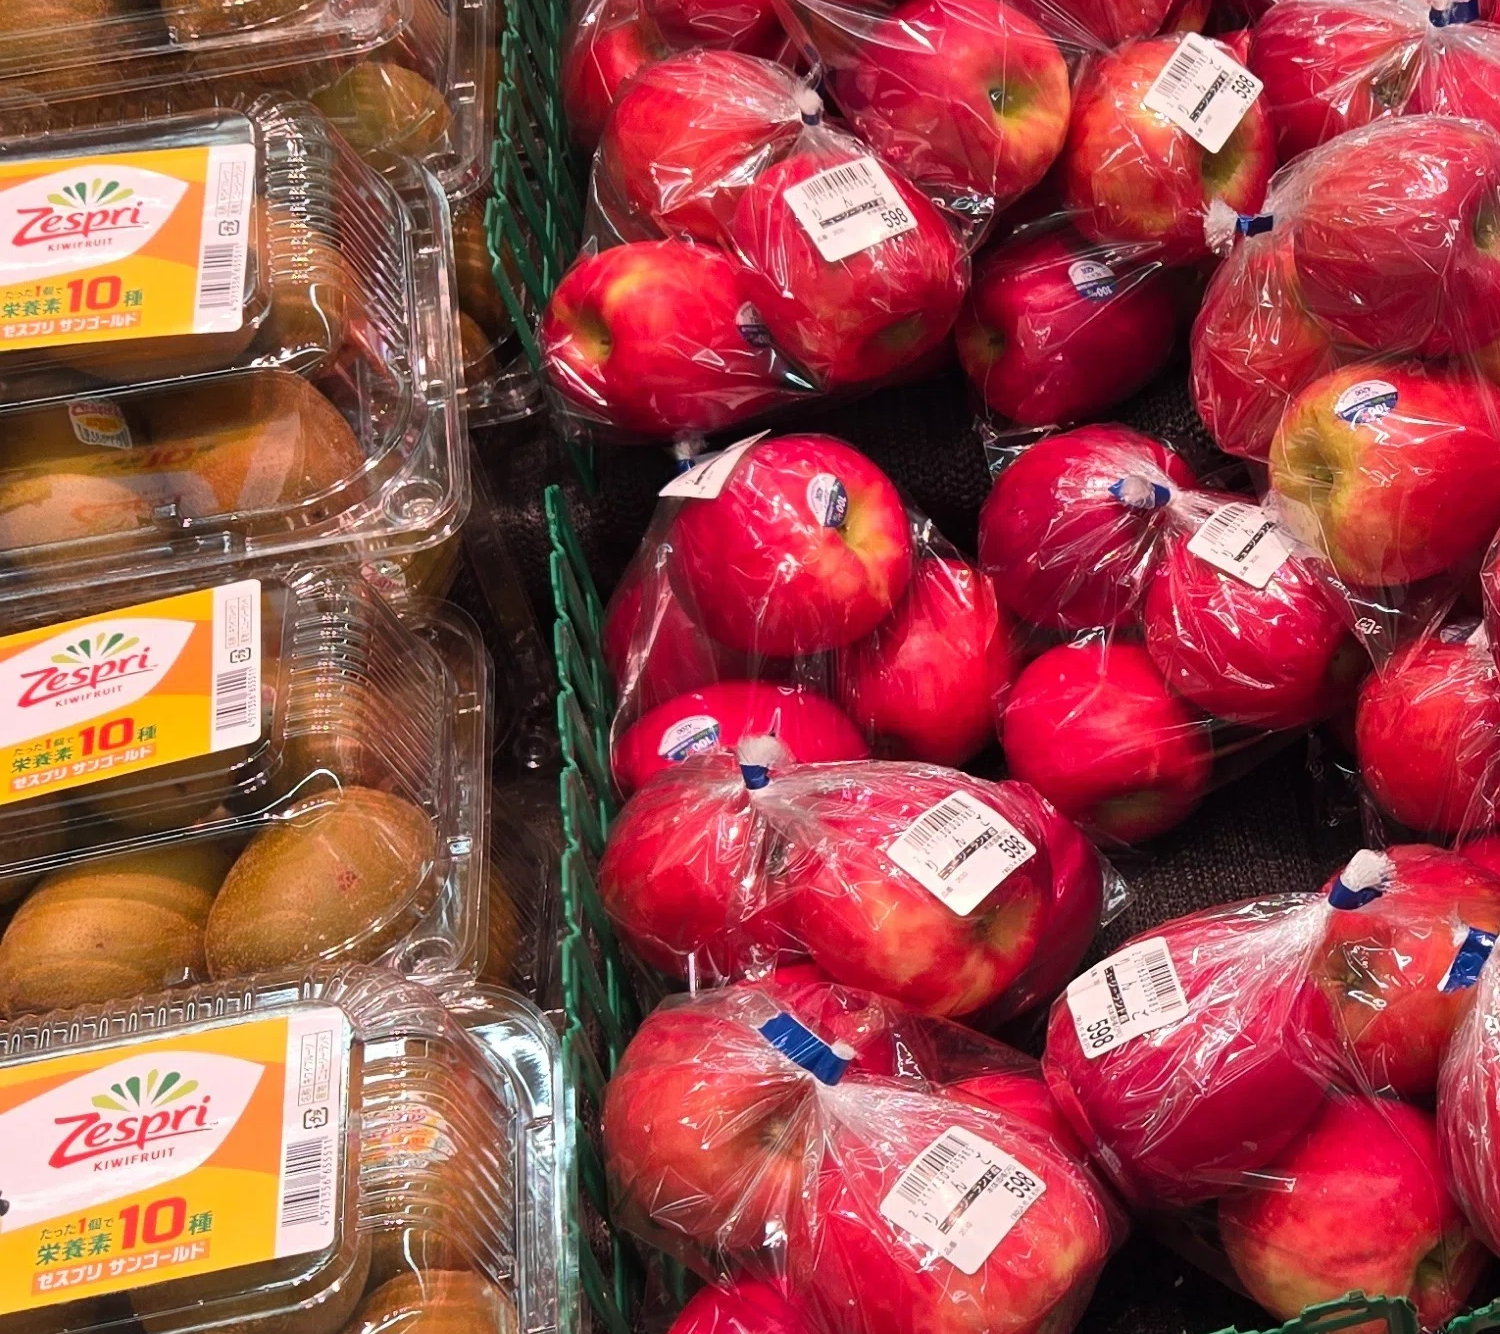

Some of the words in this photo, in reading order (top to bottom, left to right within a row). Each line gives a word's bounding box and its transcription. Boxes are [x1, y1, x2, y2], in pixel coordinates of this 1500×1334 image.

[1231, 73, 1256, 100] 598
[12, 202, 142, 248] Zespri
[881, 207, 908, 229] 598
[47, 237, 113, 252] KIWIFRUIT
[3, 319, 55, 338] ゼスプリ
[60, 312, 139, 333] サンゴールド
[18, 646, 151, 708] Zespri
[55, 684, 123, 708] KIWIFRUIT
[13, 768, 68, 788] ゼスプリ
[73, 746, 153, 775] サンゴールド
[998, 834, 1028, 860] 598
[1086, 1018, 1114, 1050] 598
[48, 1095, 211, 1169] Zespri
[93, 1146, 176, 1172] KIWIFRUIT
[1002, 1170, 1037, 1200] 598
[39, 1217, 113, 1242] たった1個で
[38, 1264, 102, 1291] ゼスプリ
[108, 1242, 205, 1278] サンゴールド
